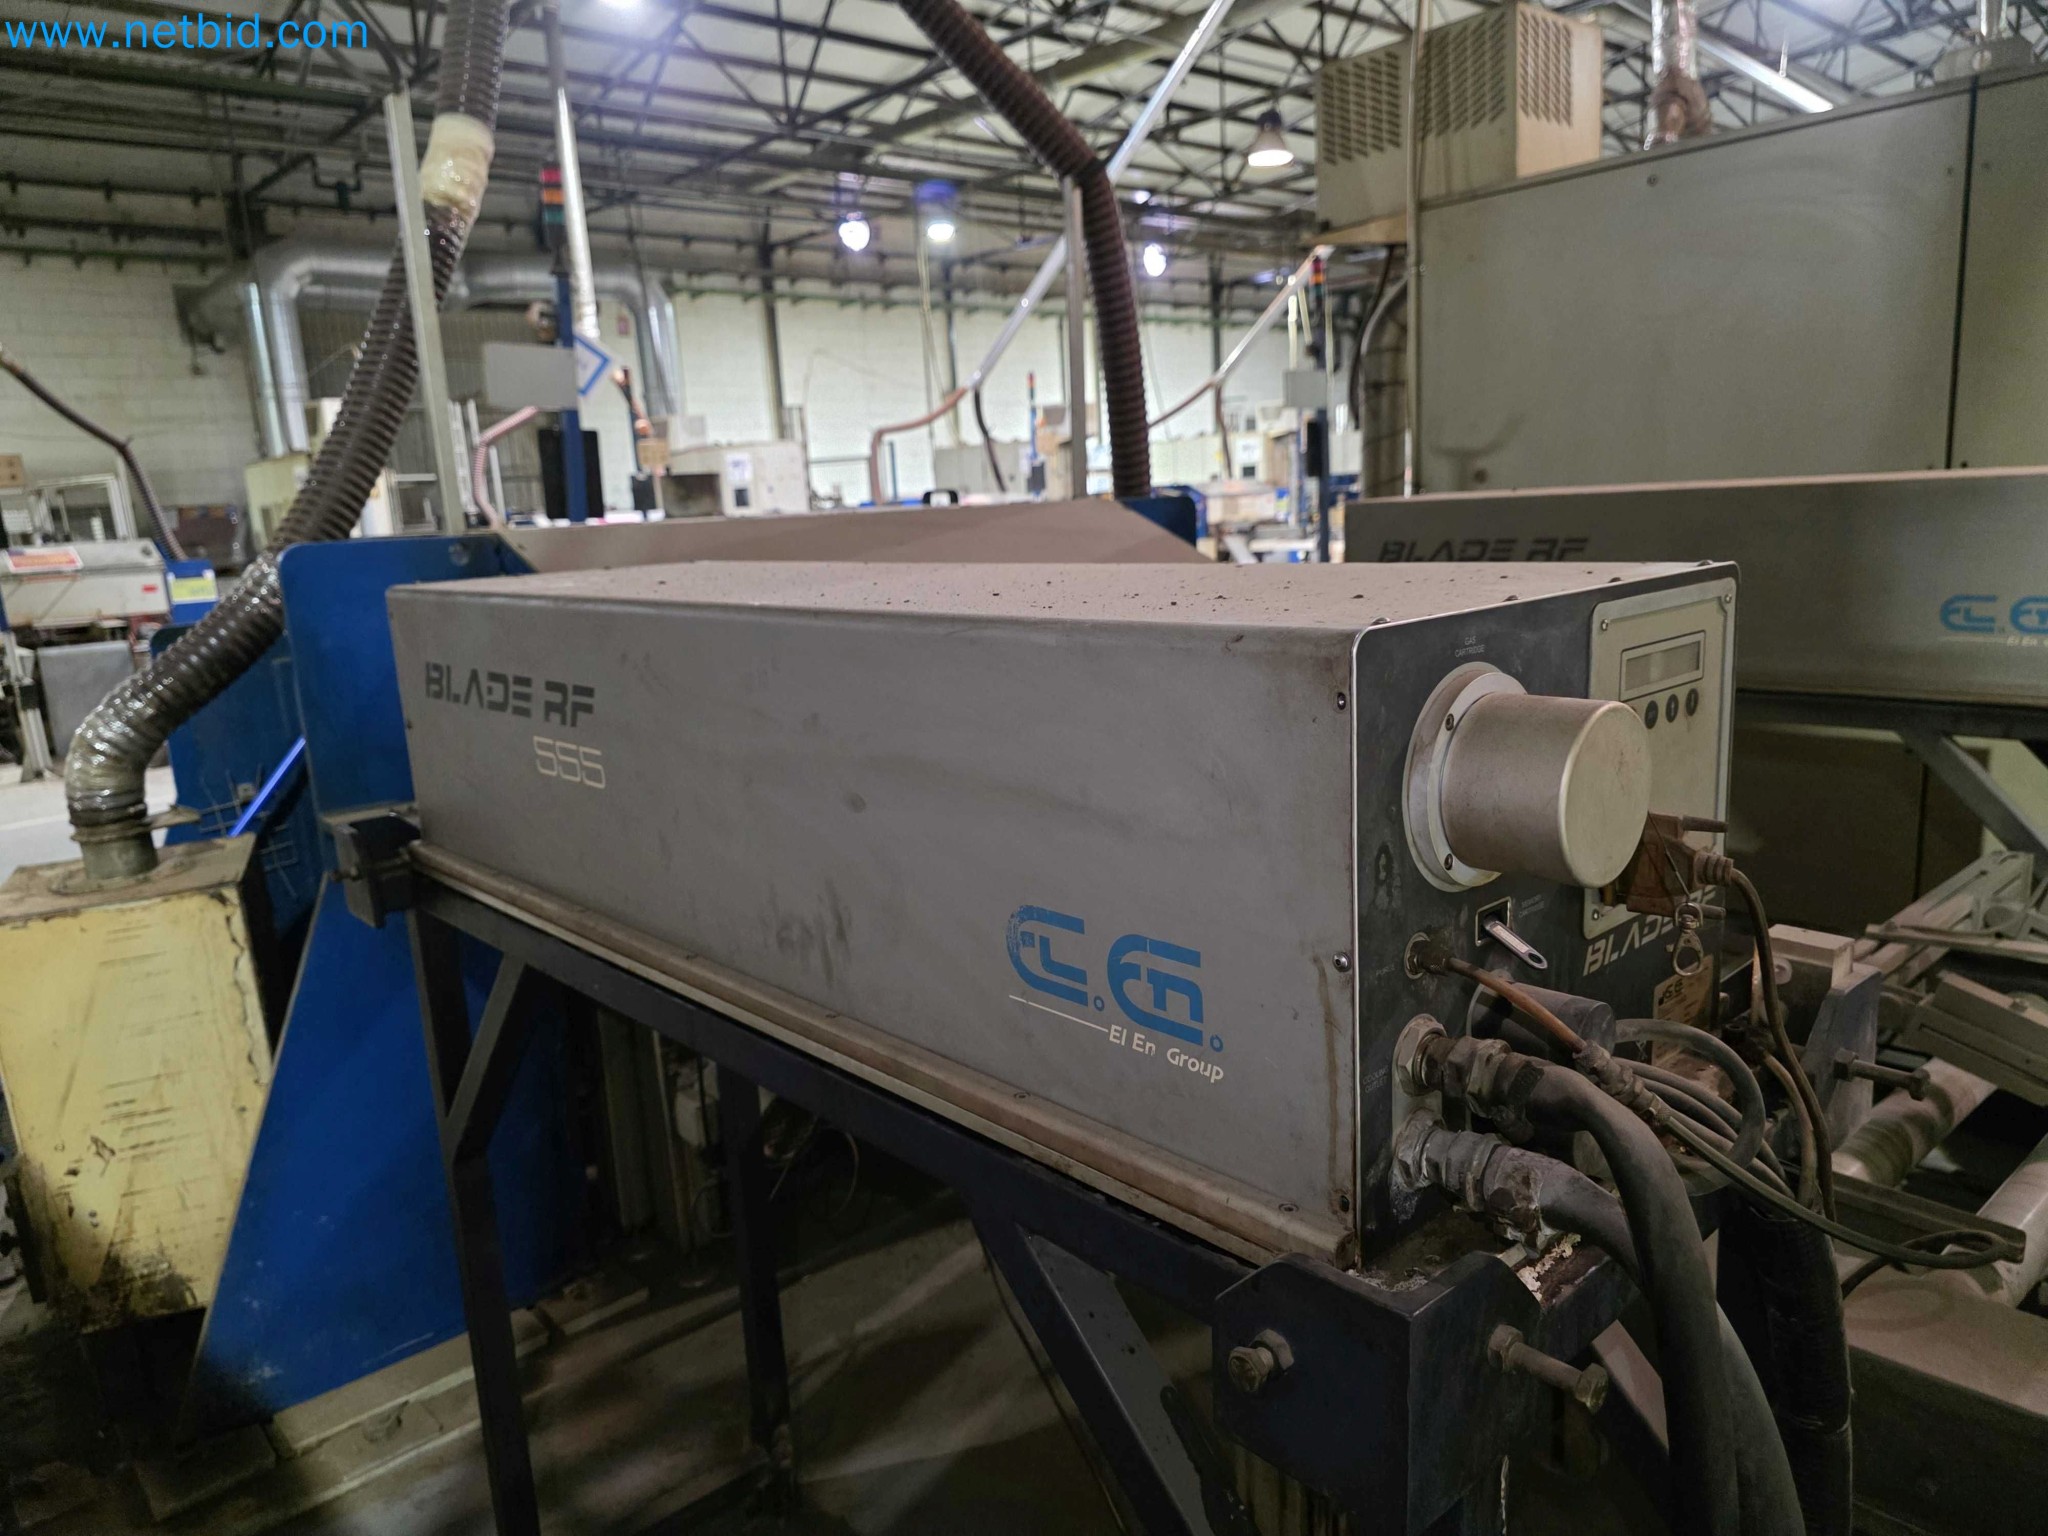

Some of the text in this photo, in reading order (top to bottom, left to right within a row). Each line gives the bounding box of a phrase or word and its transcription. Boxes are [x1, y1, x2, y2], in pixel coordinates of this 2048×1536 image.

[1377, 536, 1589, 562] BLADE RF
[425, 661, 595, 728] BLADE RF
[533, 735, 606, 789] 555
[1109, 1024, 1224, 1083] El En Group
